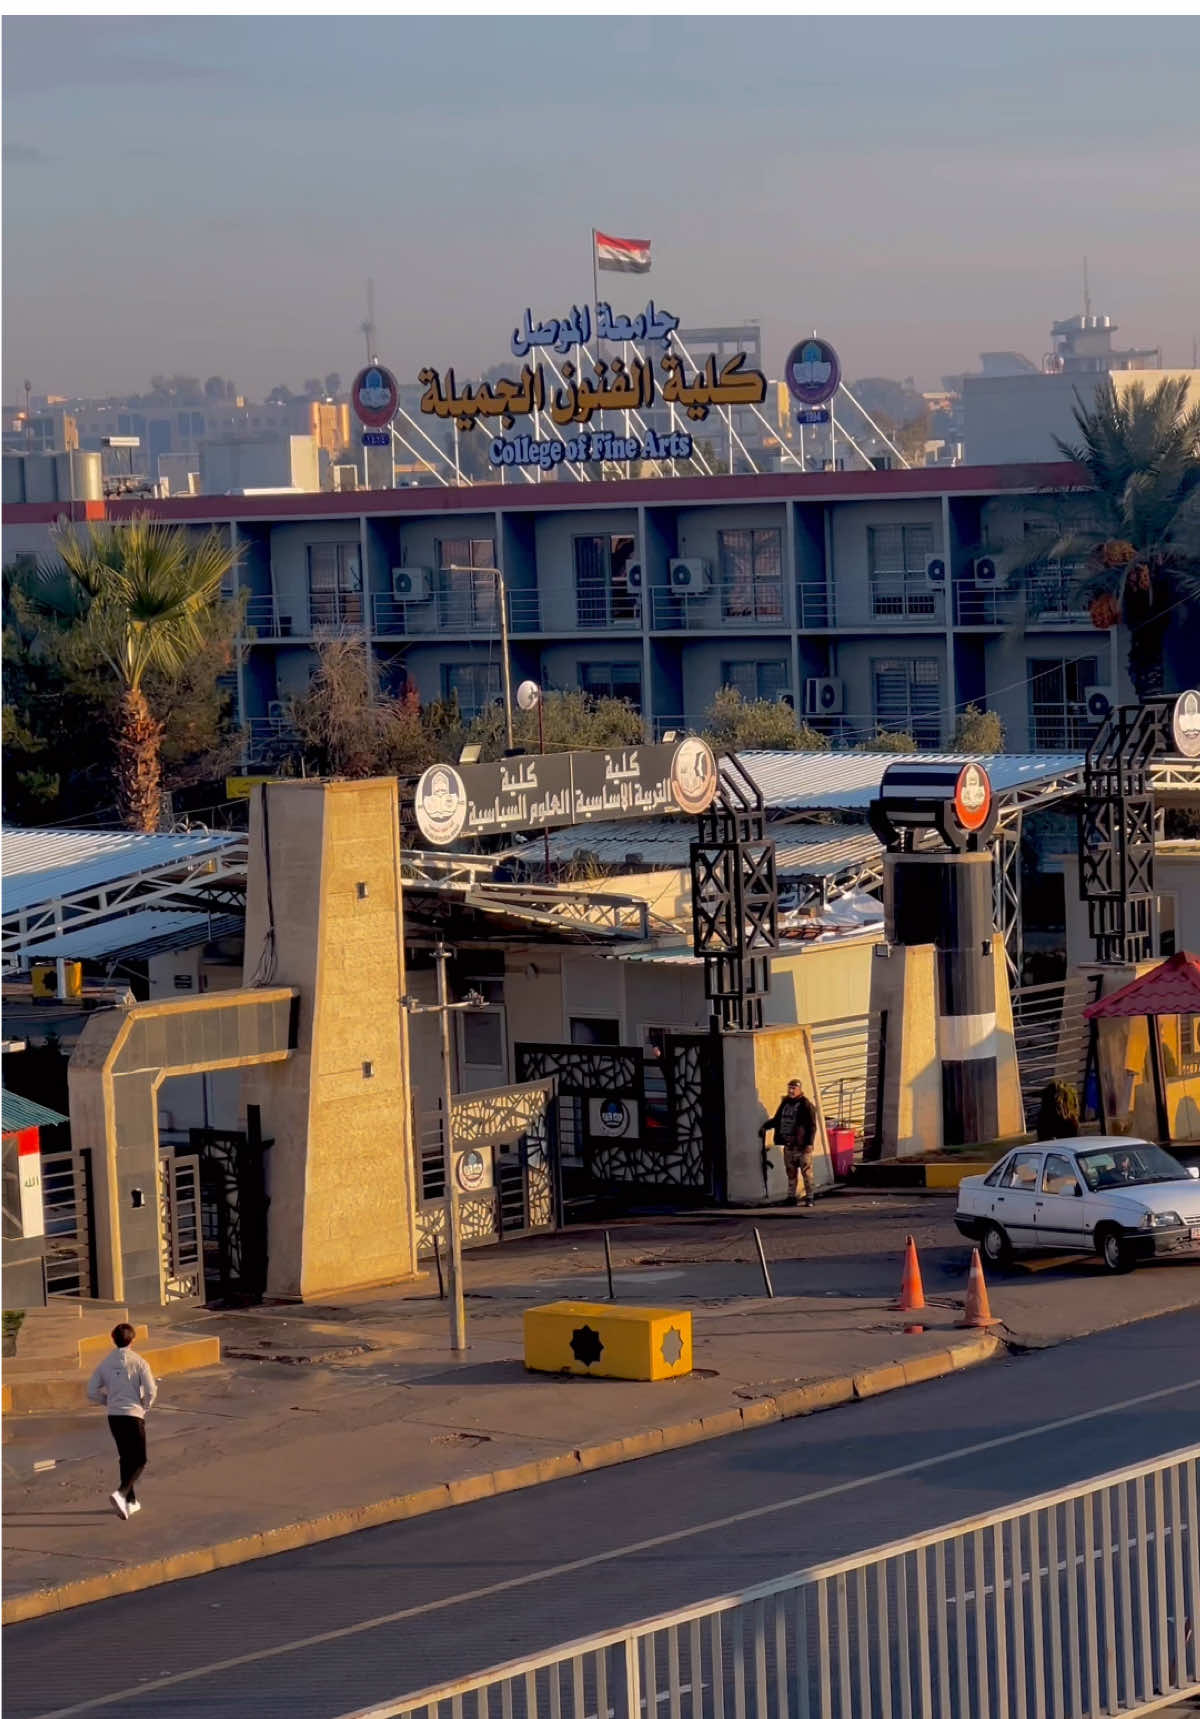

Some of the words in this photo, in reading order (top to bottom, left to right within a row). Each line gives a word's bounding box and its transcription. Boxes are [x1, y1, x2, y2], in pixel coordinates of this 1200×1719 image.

[511, 304, 591, 357] الموصل
[597, 300, 680, 349] جامعة
[417, 362, 546, 431] الجميلة
[550, 356, 655, 426] الفنون
[661, 351, 768, 421] كلية
[488, 434, 565, 470] College
[564, 431, 592, 461] of
[590, 430, 642, 461] Fine
[641, 428, 693, 460] Arts
[500, 760, 538, 797] كلية
[604, 750, 641, 785] كلية
[468, 793, 527, 831] السياسية
[529, 787, 570, 825] العلوم
[634, 777, 671, 812] التربية
